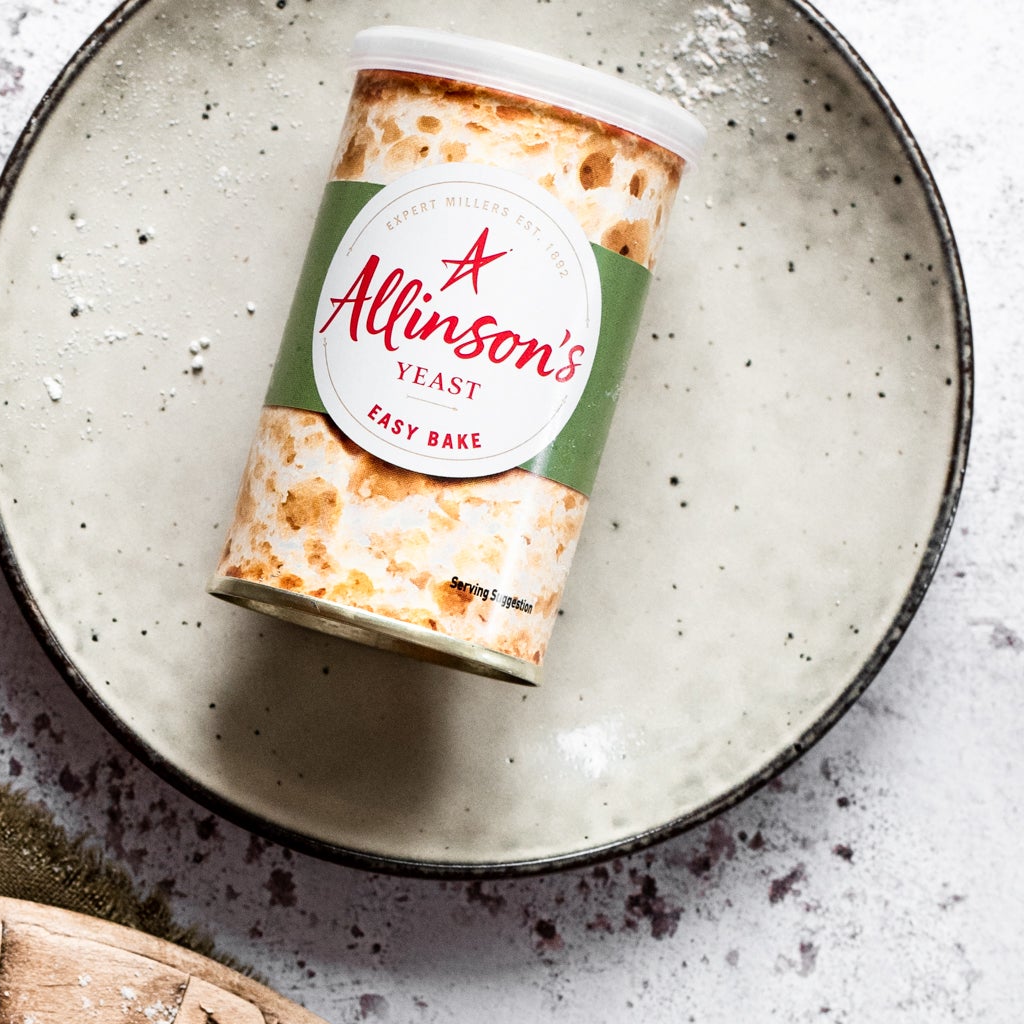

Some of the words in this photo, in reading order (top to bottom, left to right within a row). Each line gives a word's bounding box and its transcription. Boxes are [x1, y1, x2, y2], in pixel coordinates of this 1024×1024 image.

[386, 200, 436, 231] EXPERT
[445, 197, 509, 217] MILLERS
[515, 214, 541, 241] EST.
[545, 243, 569, 278] 1892
[319, 254, 585, 383] Allinson's
[396, 361, 481, 400] YEAST
[367, 404, 419, 440] EASY
[427, 432, 482, 449] BAKE
[449, 576, 489, 602] Serving
